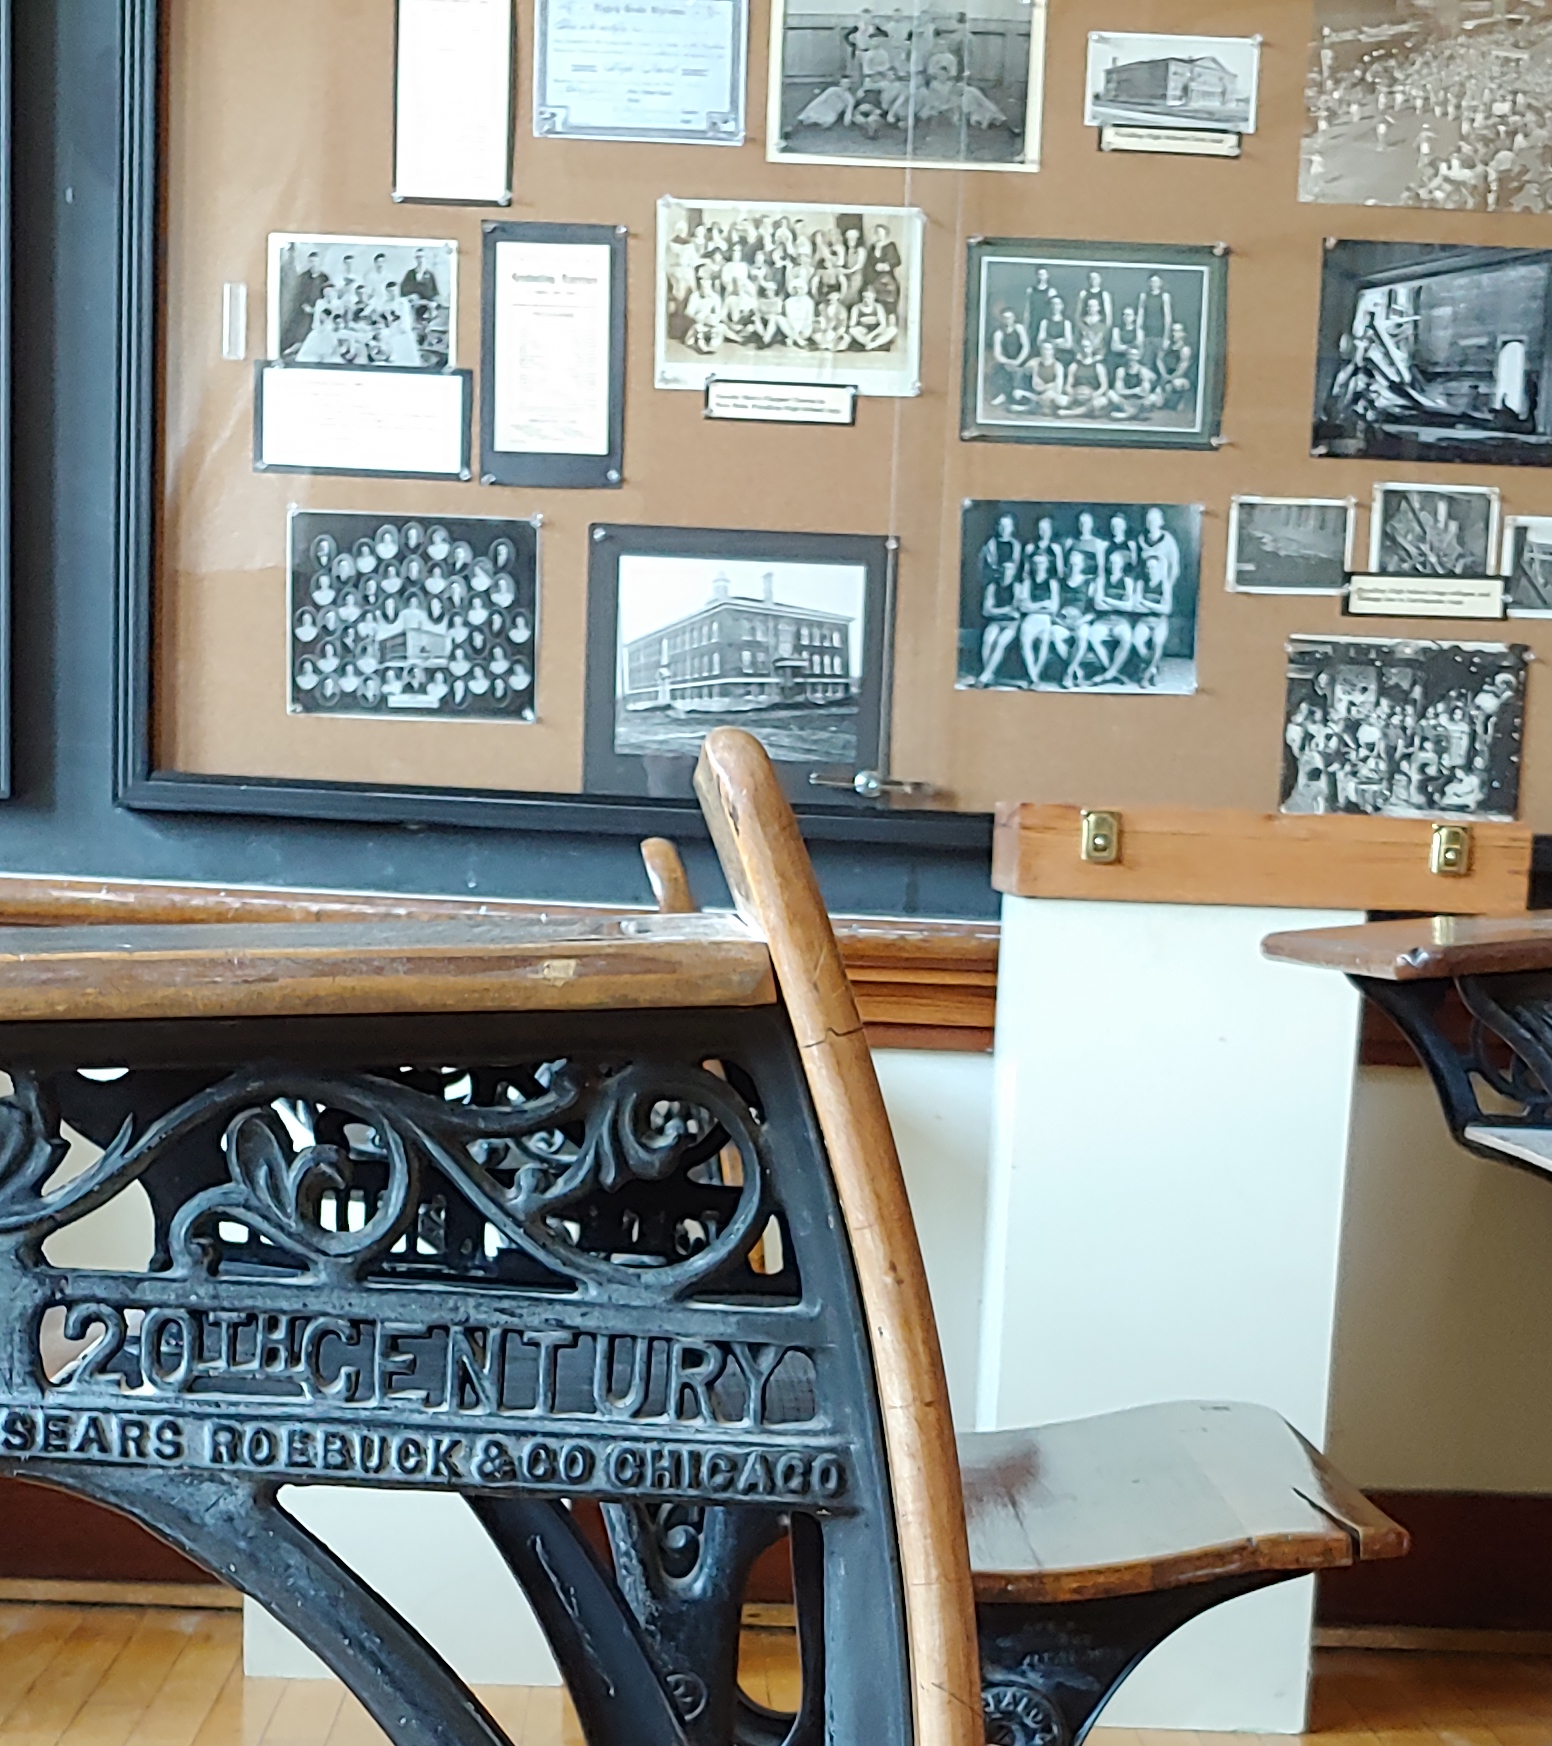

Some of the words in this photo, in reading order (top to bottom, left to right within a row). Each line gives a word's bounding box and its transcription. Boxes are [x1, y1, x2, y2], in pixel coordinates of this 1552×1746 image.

[64, 1302, 301, 1396] 20TH
[301, 1314, 781, 1430] CENTURY
[0, 1410, 184, 1460] SEARS
[208, 1421, 463, 1479] ROEBUCK
[607, 1443, 847, 1500] CHICAGO
